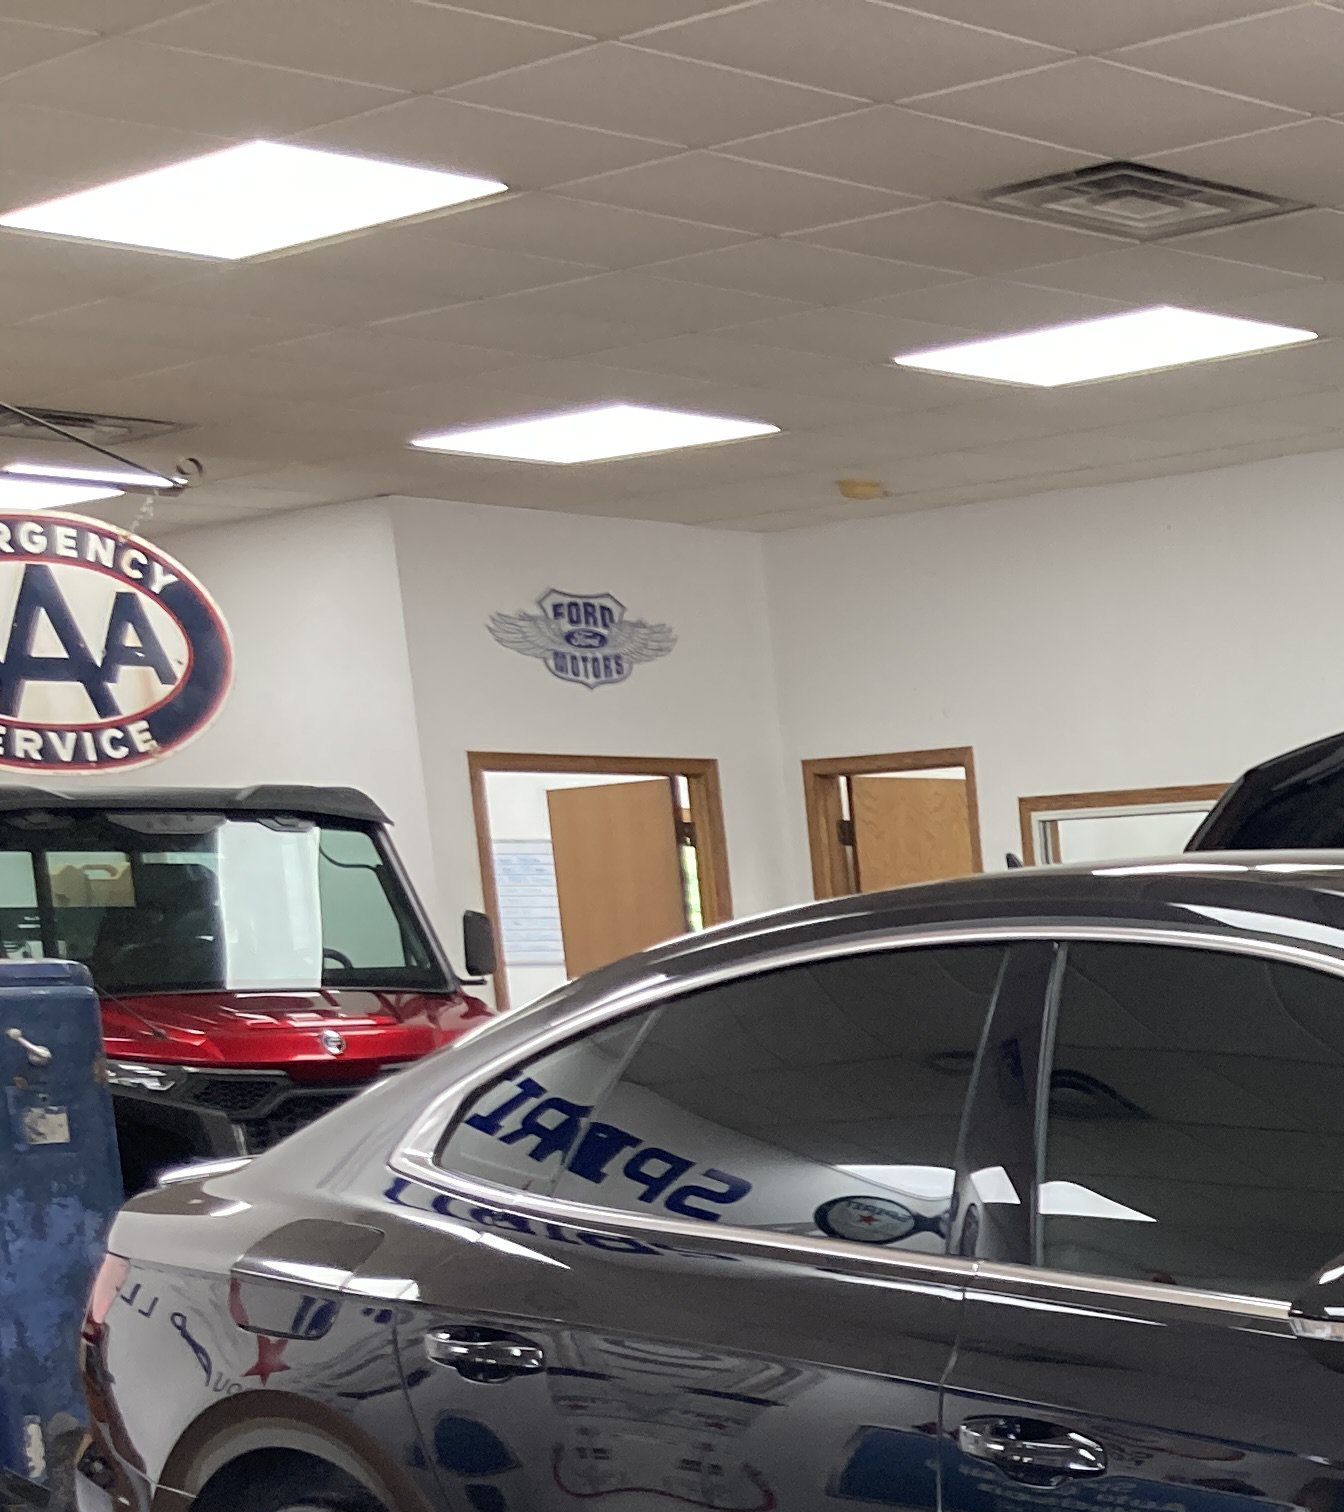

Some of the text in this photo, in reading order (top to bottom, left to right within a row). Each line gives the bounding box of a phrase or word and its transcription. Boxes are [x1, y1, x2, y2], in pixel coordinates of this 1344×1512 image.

[552, 601, 615, 628] FORD
[552, 650, 625, 680] MOTORS
[0, 719, 160, 763] RVICE
